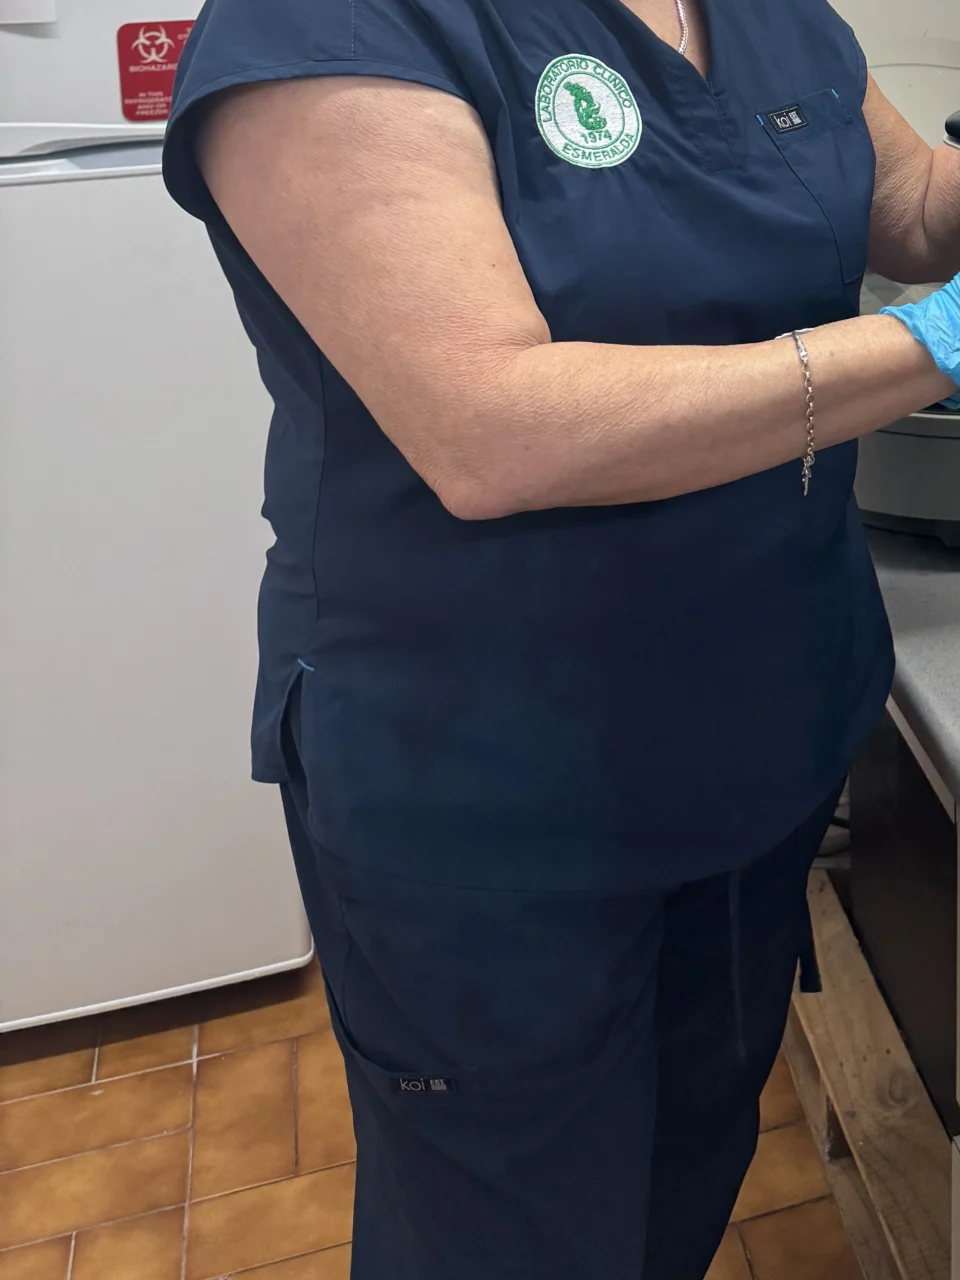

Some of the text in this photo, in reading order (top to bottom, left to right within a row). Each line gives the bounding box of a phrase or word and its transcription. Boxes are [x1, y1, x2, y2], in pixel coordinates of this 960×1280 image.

[540, 59, 633, 122] LABORATORIO CLINICO
[773, 112, 792, 128] koi
[580, 129, 613, 144] 1974
[562, 132, 634, 162] ESMERALDA
[400, 1078, 425, 1091] koi
